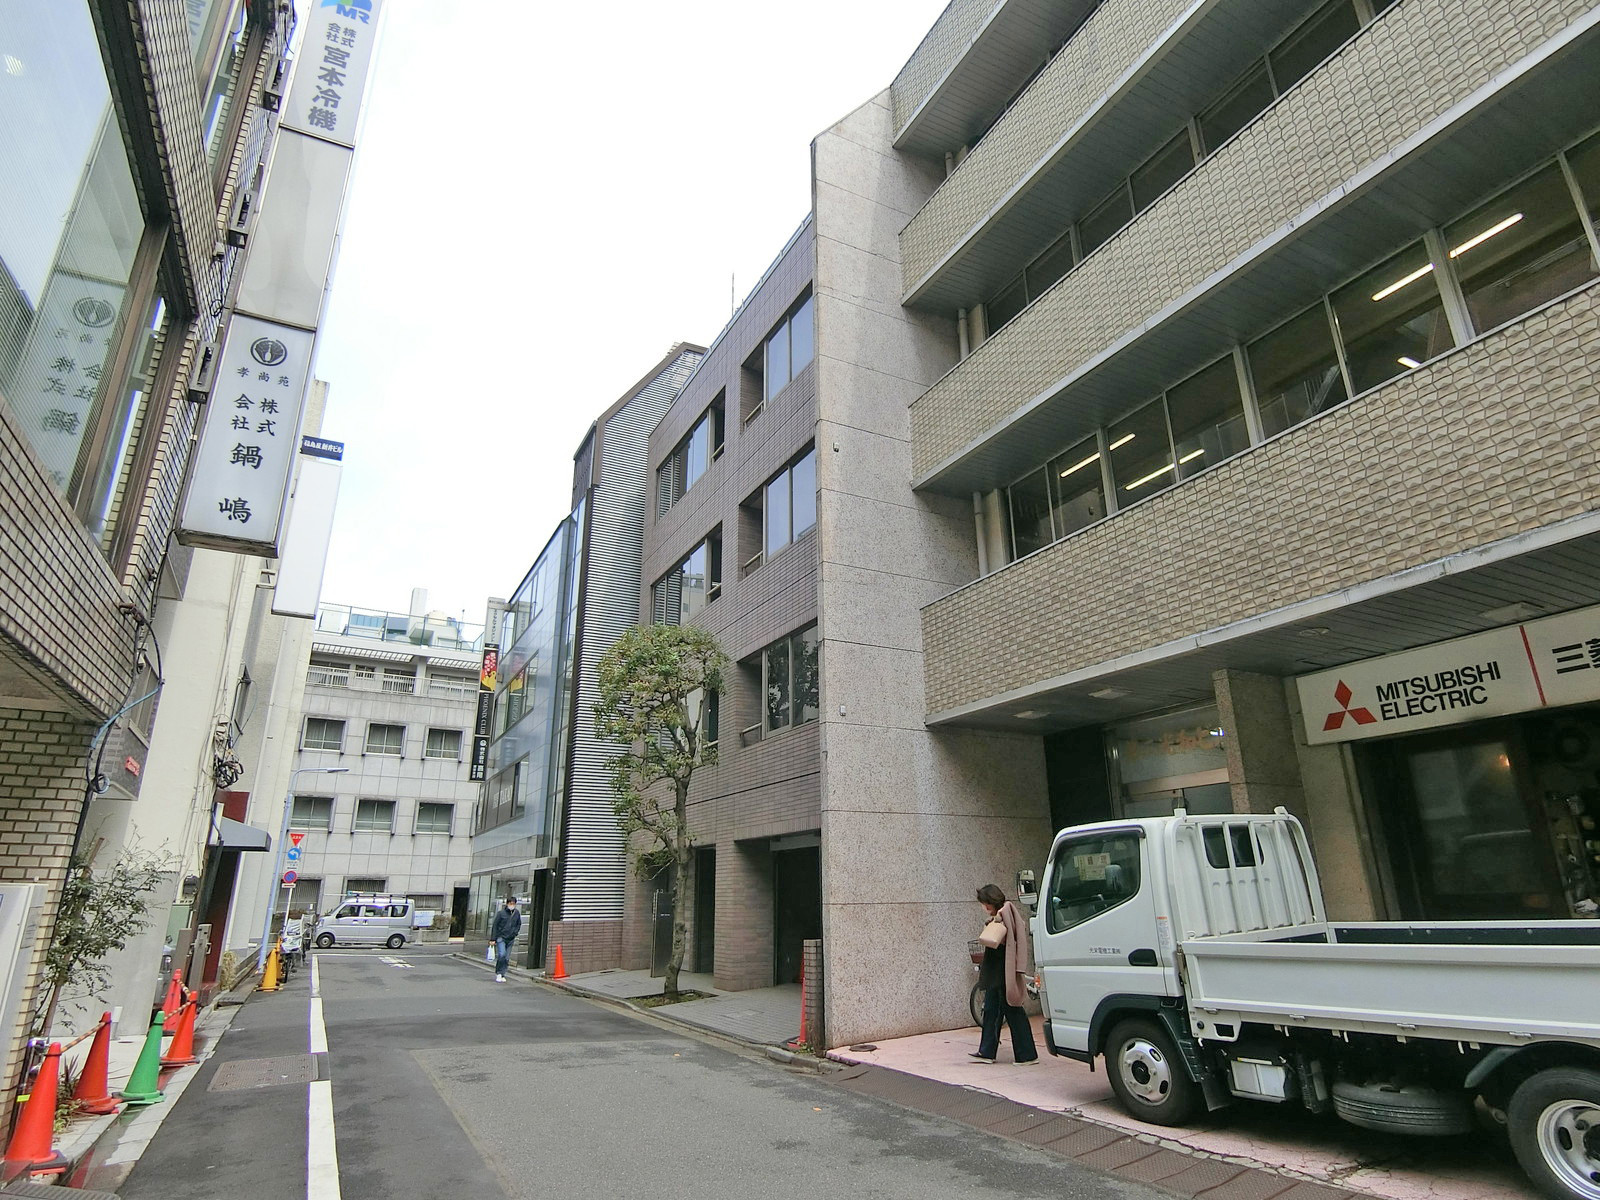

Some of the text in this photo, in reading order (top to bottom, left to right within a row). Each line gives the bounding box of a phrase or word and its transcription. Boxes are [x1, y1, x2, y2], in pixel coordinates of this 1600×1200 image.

[336, 3, 370, 25] MR
[308, 45, 351, 131] 宮本冷機
[237, 366, 290, 387] 孝尚苑
[218, 442, 264, 524] 鍋嶋
[1376, 661, 1501, 702] MITSUBISHI
[1380, 686, 1488, 721] ELECTRIC
